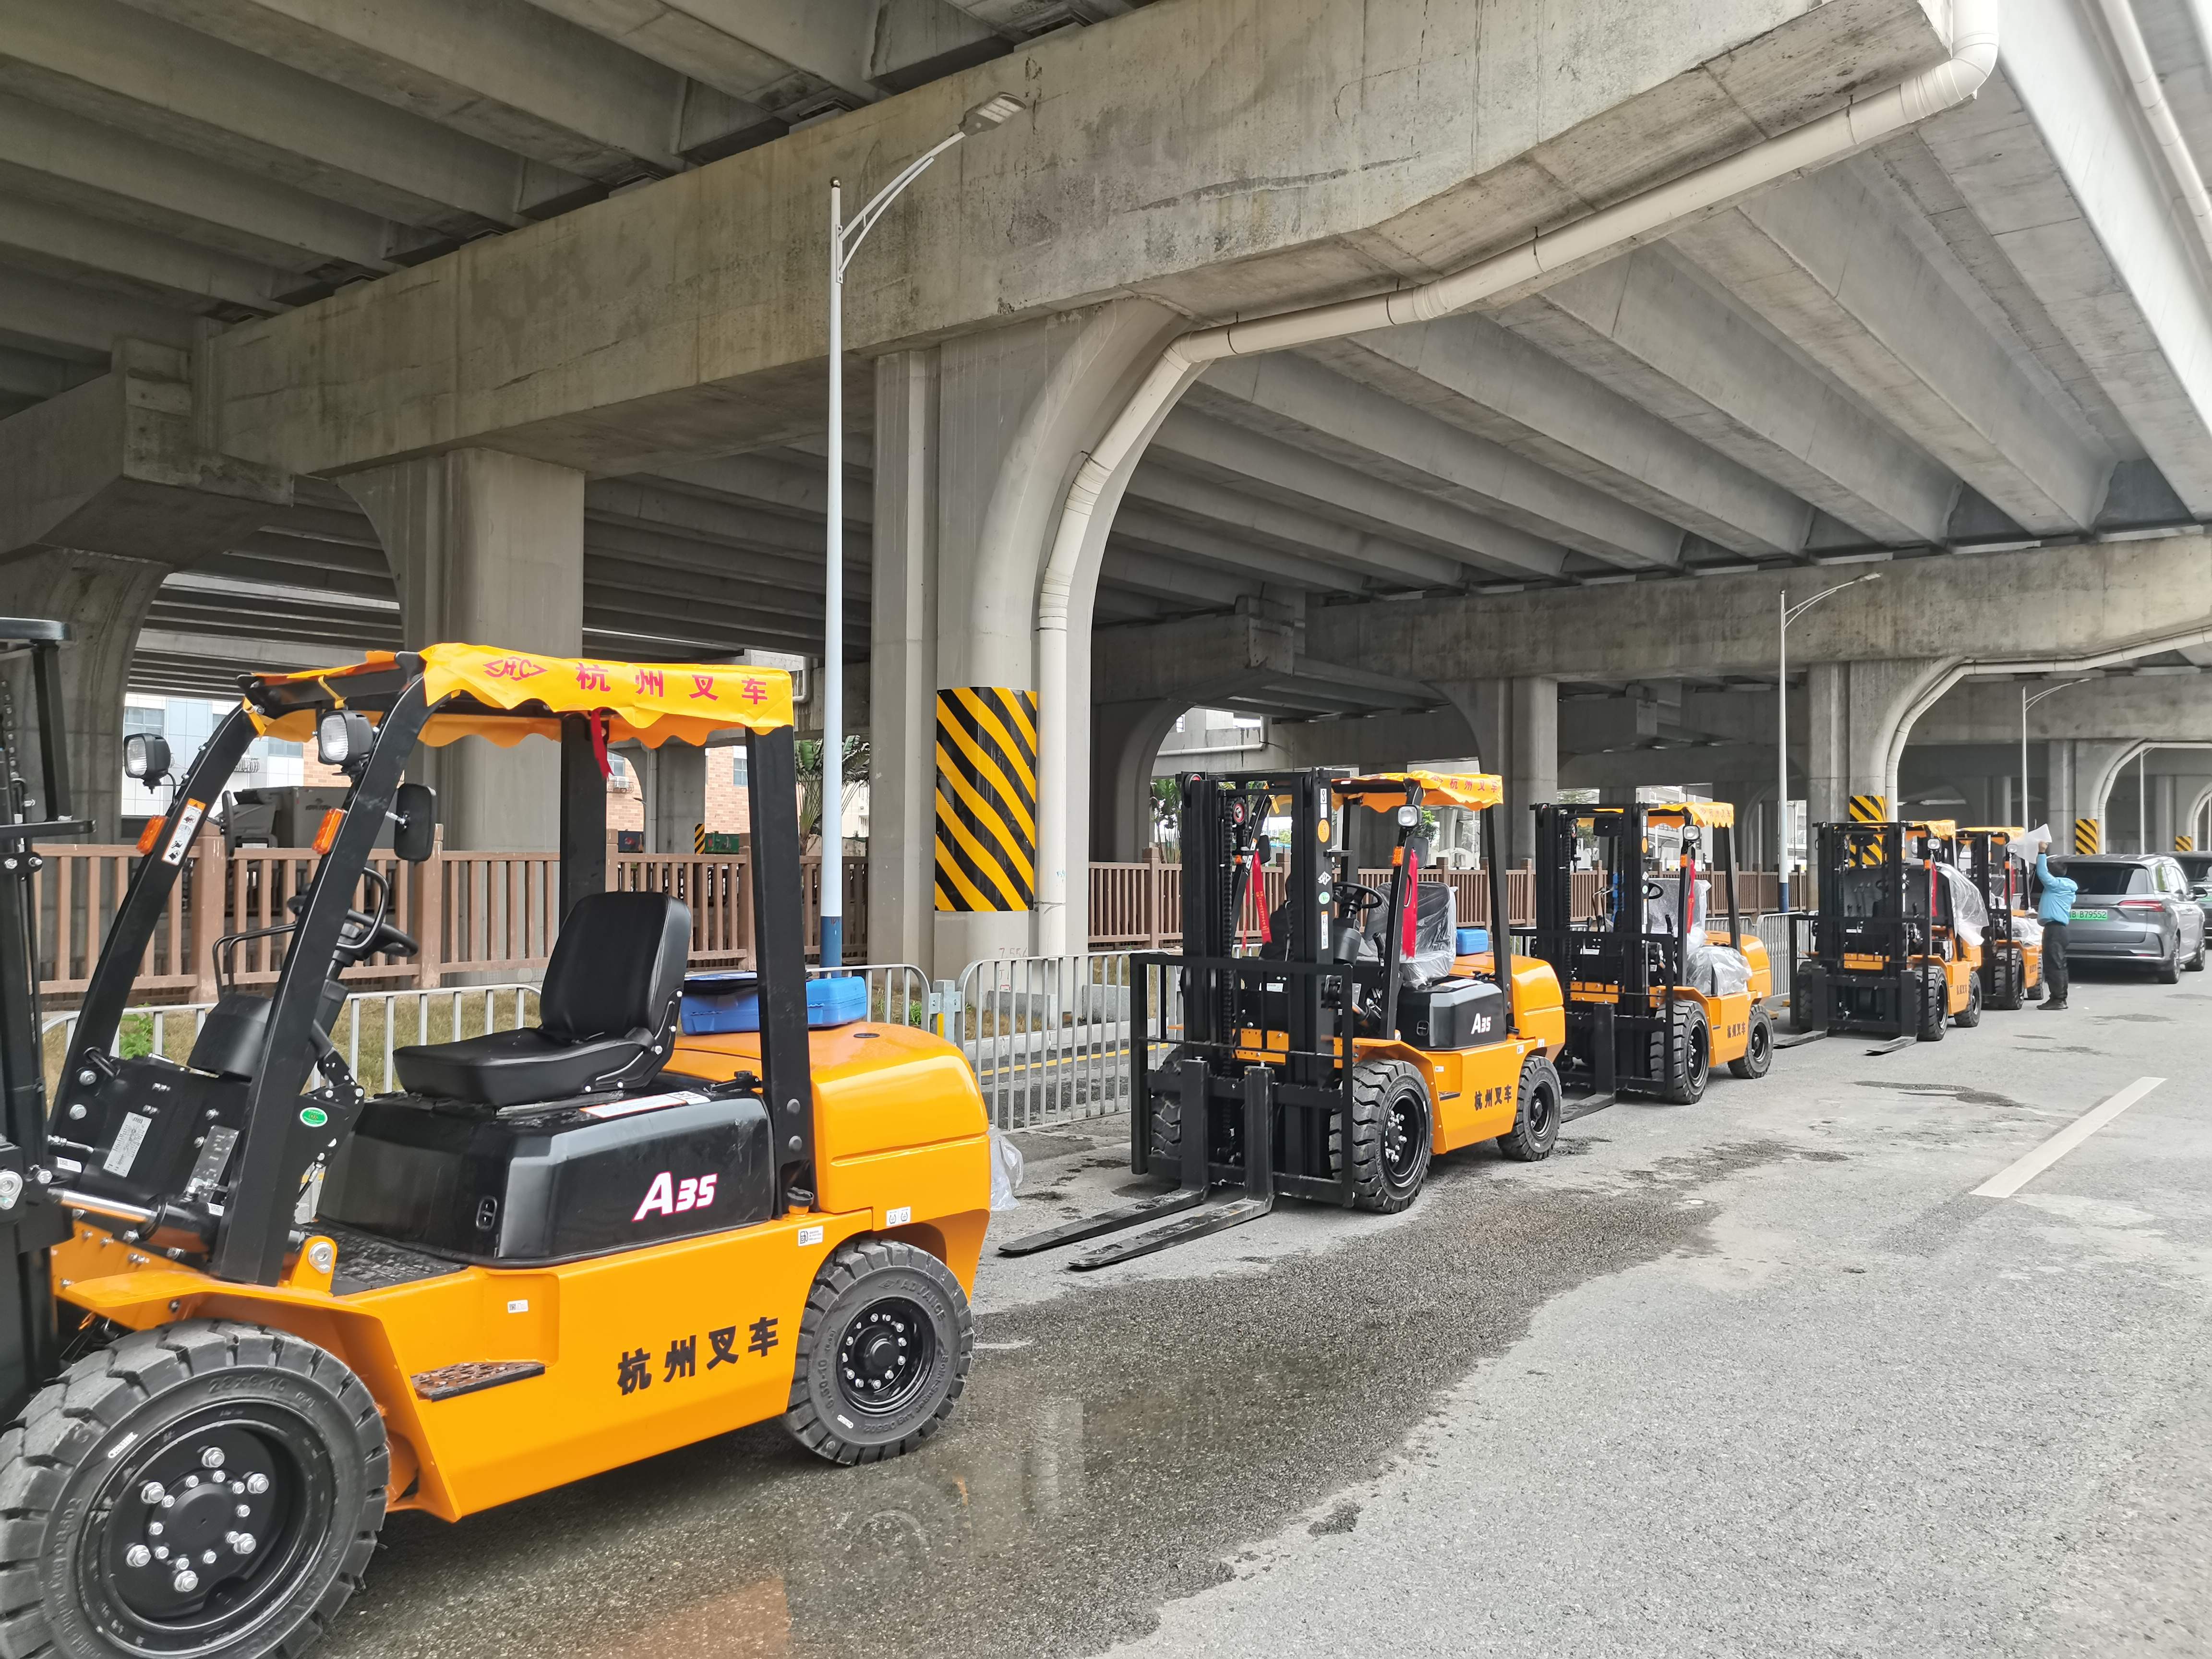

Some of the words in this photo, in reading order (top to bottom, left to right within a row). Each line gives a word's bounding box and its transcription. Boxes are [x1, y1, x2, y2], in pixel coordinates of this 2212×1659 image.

[576, 662, 769, 705] 杭州叉车
[1449, 777, 1498, 793] 杭州叉车
[1471, 1013, 1491, 1034] A35
[1474, 1084, 1512, 1111] 杭州叉车
[631, 1171, 718, 1222] A35
[900, 1278, 946, 1322] ADVANCE
[617, 1317, 779, 1396] 杭州叉车
